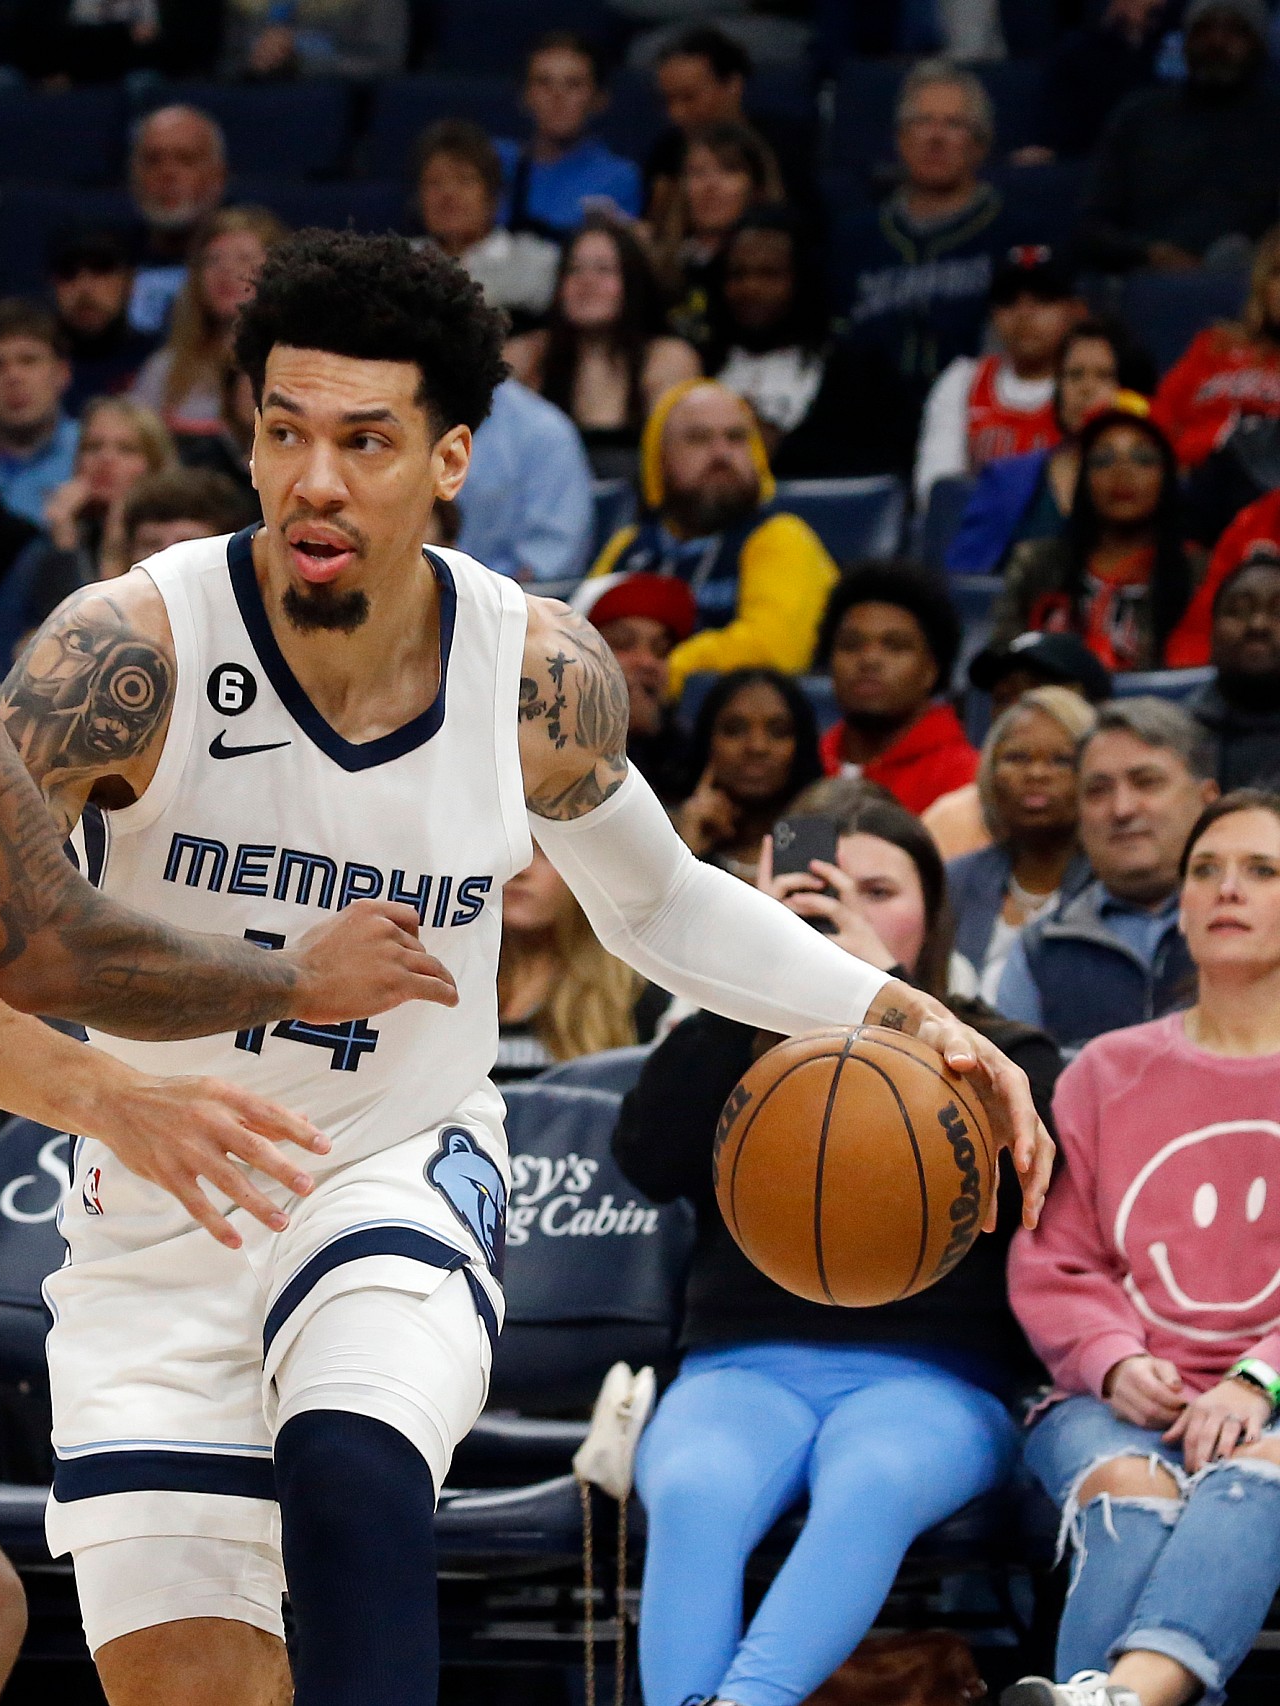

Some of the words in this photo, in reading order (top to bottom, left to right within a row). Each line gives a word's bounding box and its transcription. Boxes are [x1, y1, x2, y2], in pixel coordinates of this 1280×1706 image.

[218, 670, 245, 710] 6
[163, 832, 493, 928] MEMPHIS
[539, 1194, 659, 1237] Cabin
